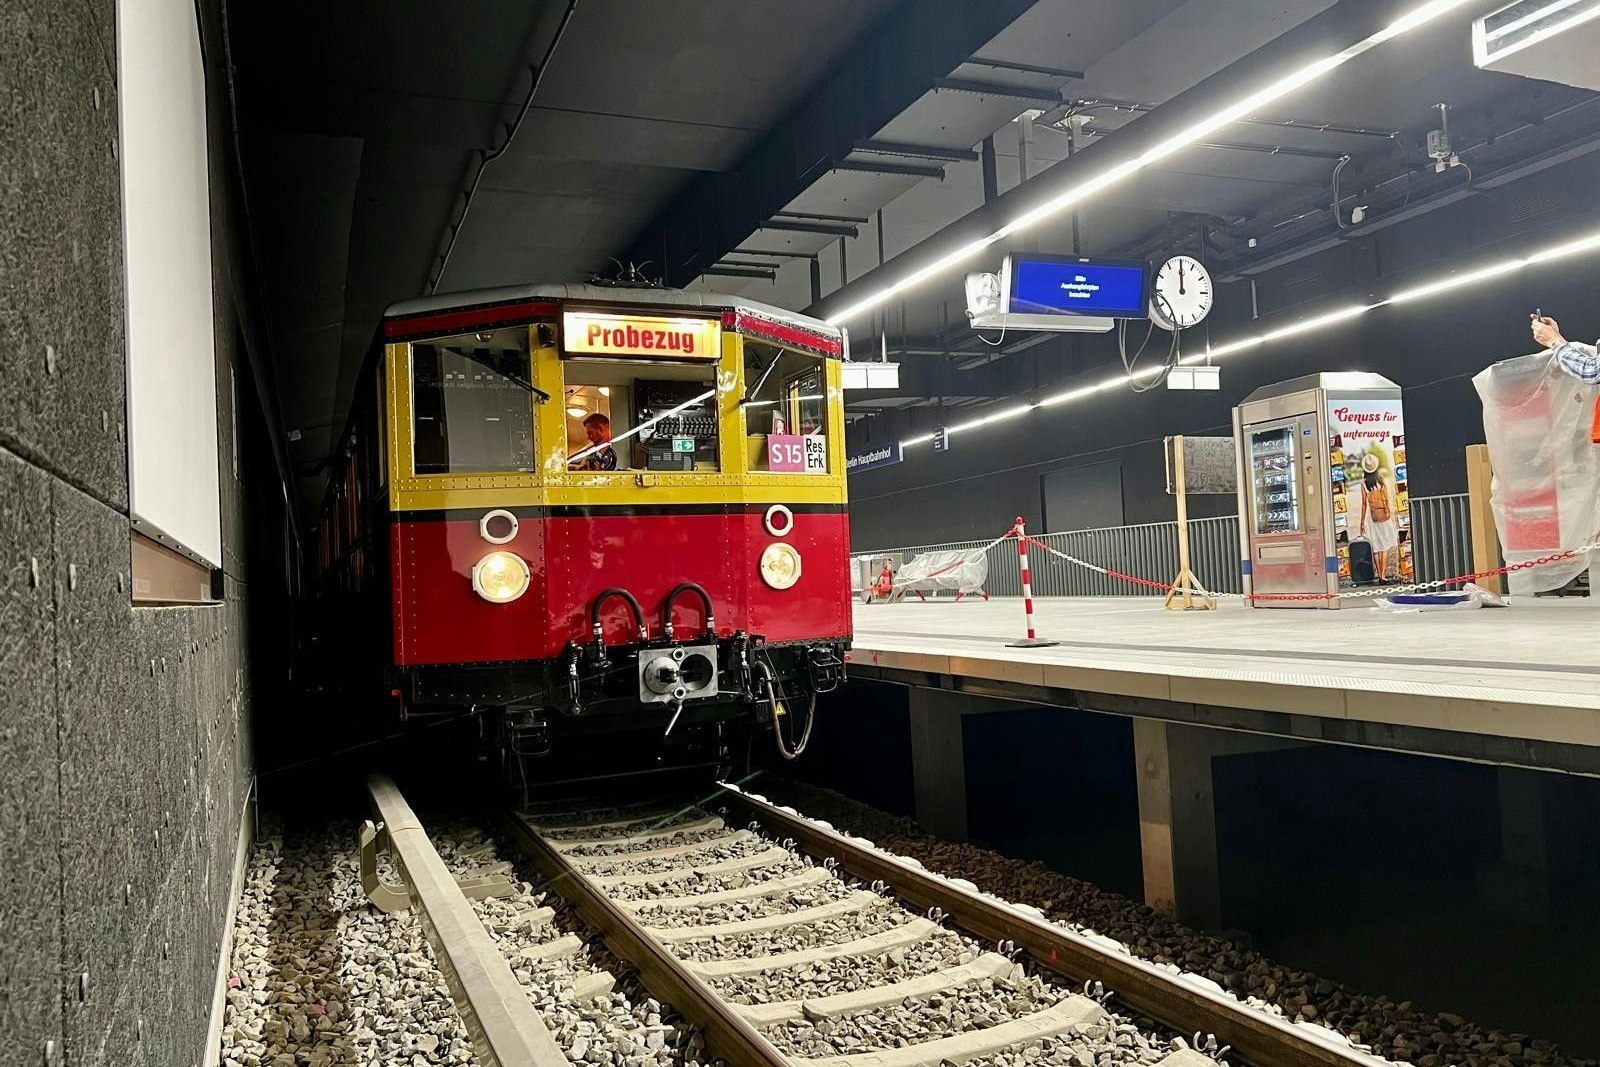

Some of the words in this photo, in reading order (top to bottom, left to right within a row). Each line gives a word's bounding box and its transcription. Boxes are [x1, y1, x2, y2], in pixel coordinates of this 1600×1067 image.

[587, 323, 695, 353] Probezug
[1334, 407, 1381, 424] Genuss
[1383, 411, 1397, 422] für
[1343, 429, 1391, 442] unterwegs
[772, 443, 783, 464] S
[785, 444, 802, 464] 15
[805, 437, 825, 453] Res.
[807, 453, 824, 468] Erk
[858, 446, 891, 466] Hauptbahnhof
